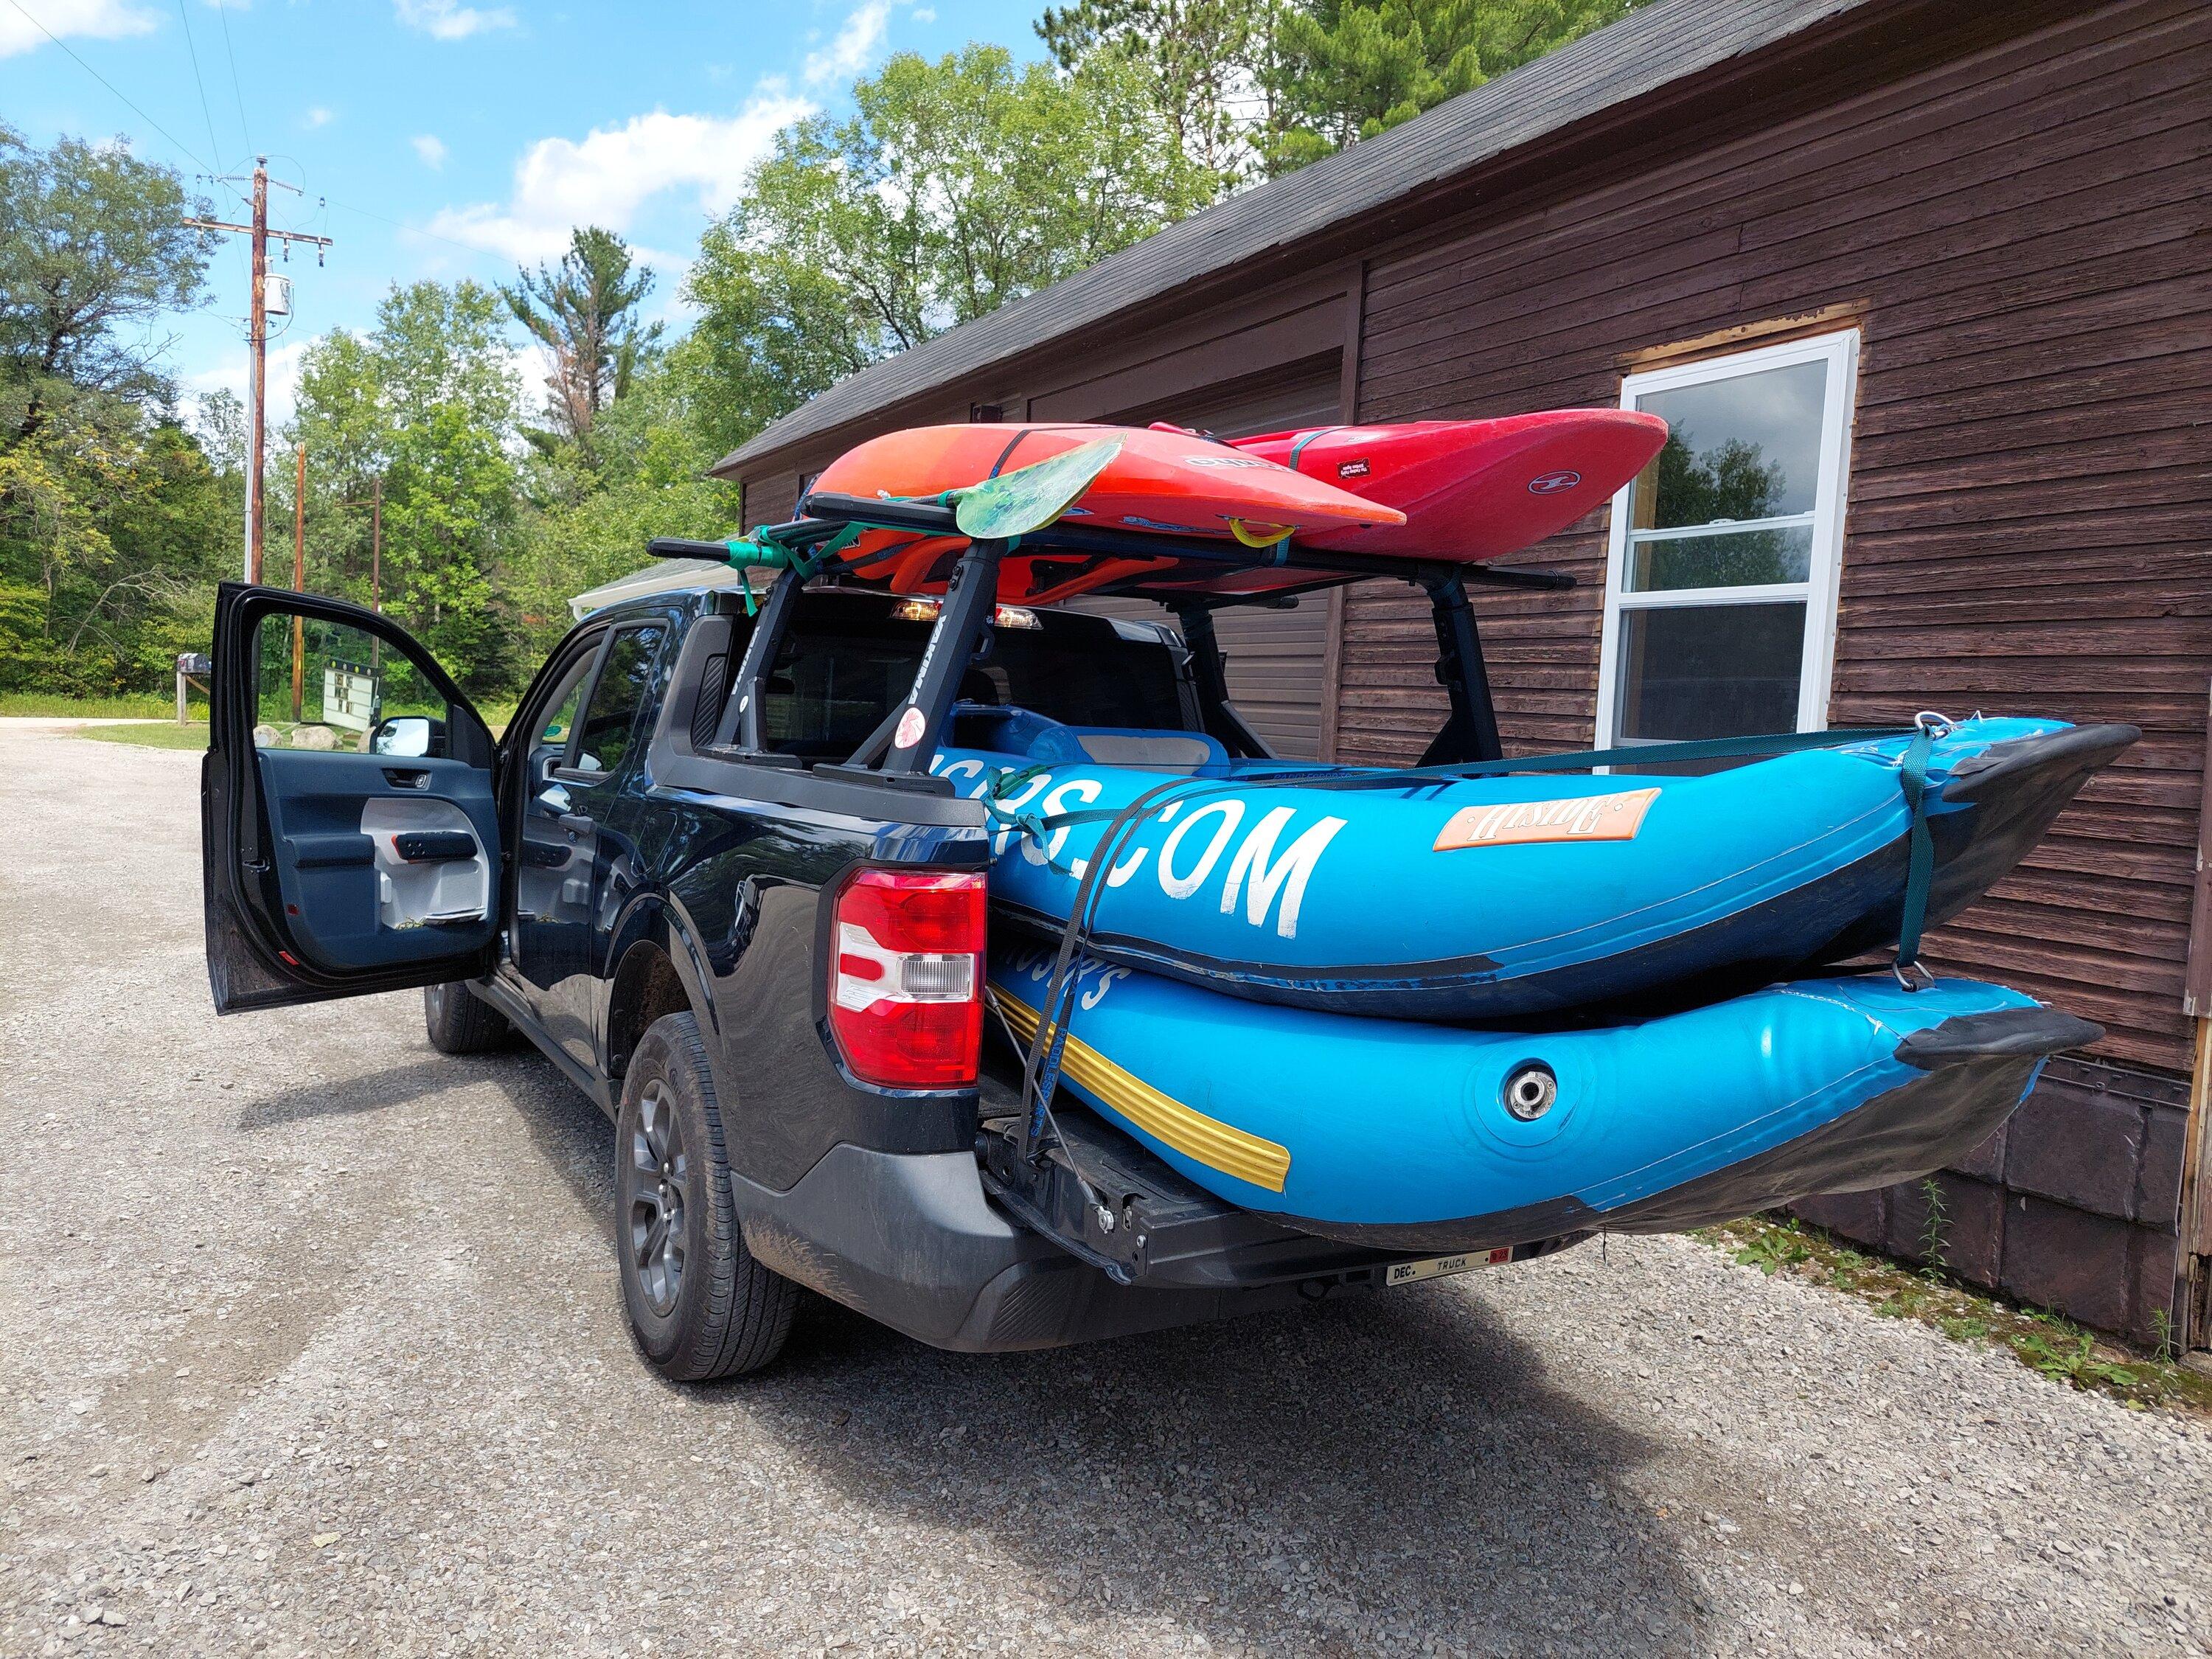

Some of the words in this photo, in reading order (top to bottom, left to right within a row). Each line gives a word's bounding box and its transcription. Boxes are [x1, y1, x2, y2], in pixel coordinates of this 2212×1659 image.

[908, 614, 947, 705] YAKIMA
[1467, 796, 1610, 842] HYSIDE
[1437, 1256, 1467, 1271] TRUCK
